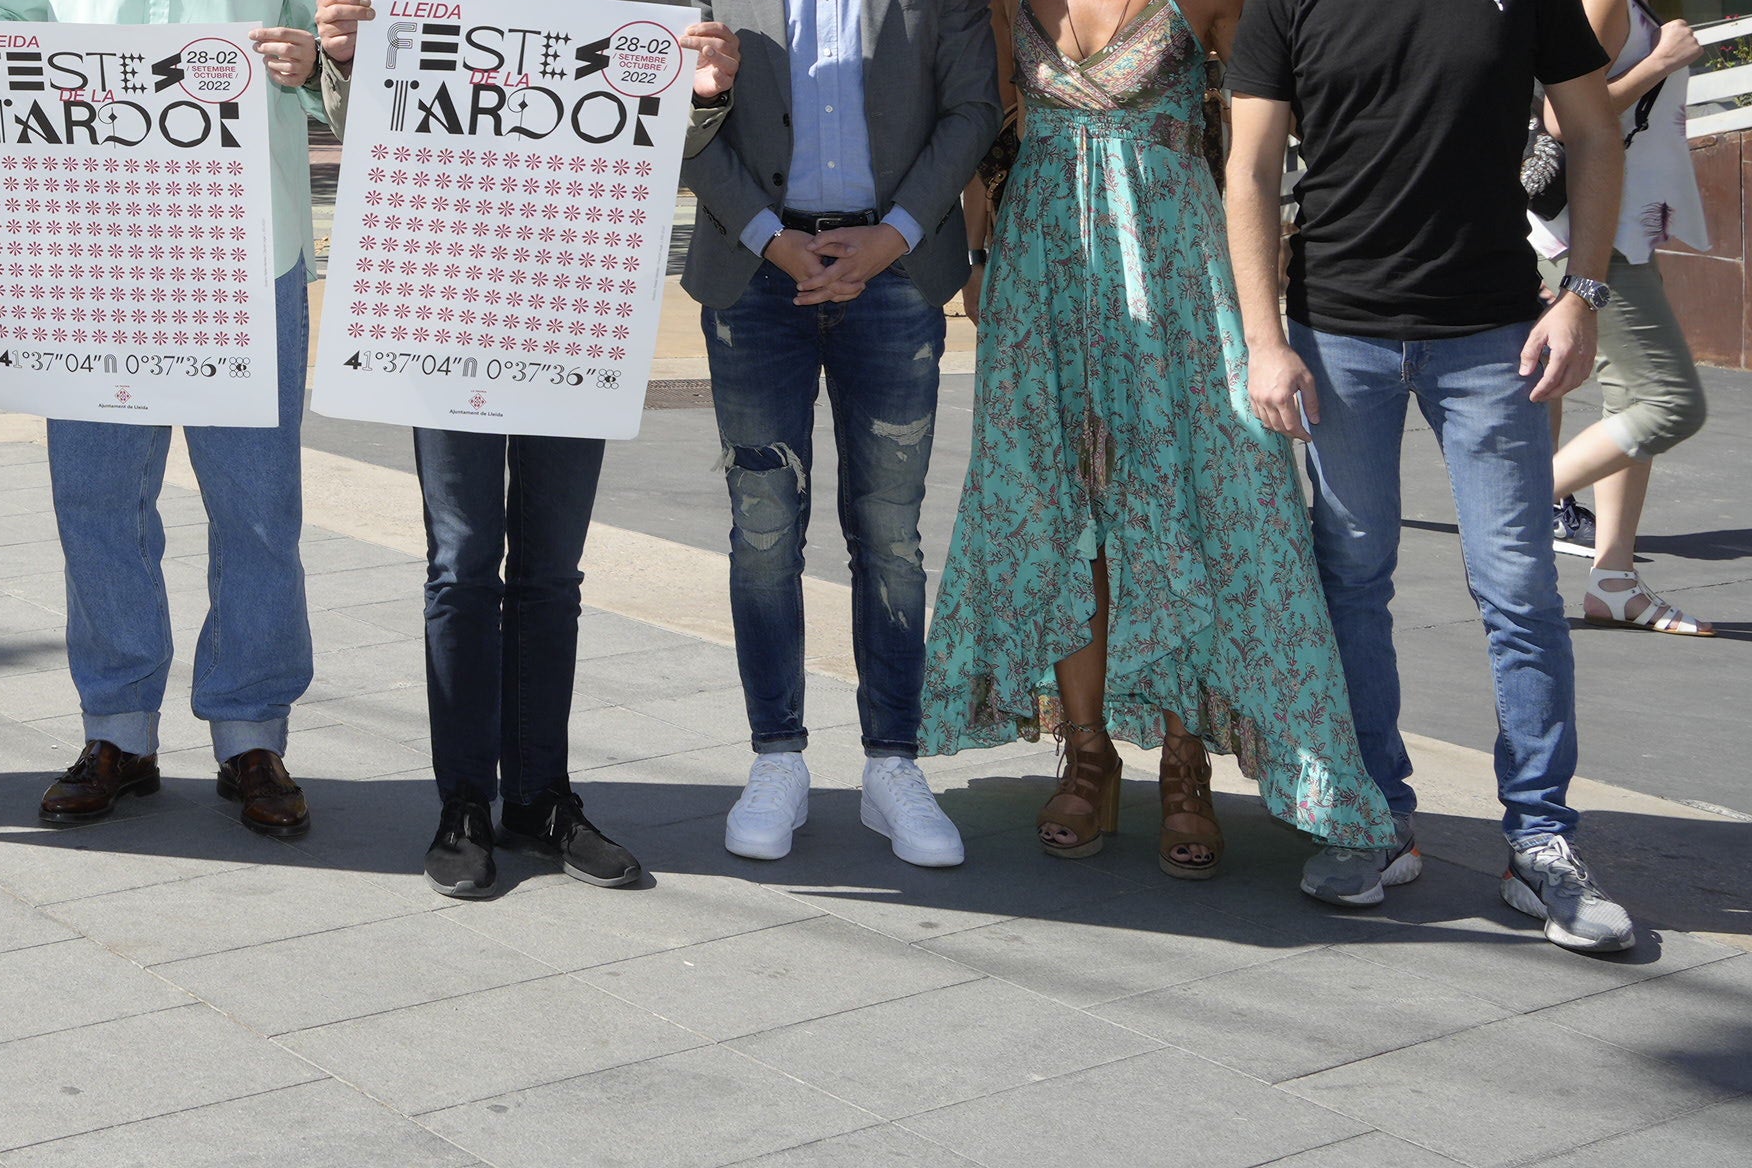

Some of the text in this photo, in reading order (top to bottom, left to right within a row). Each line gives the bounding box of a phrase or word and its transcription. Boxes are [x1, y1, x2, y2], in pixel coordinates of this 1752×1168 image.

[389, 0, 462, 20] LLEIDA
[385, 21, 611, 81] FESTES
[615, 36, 671, 55] 28-02
[186, 51, 238, 64] 28-02
[618, 53, 666, 64] SETEMBRE
[619, 61, 662, 71] OCTUBRE
[469, 69, 531, 87] DE LA
[621, 70, 657, 84] 2022
[198, 80, 231, 91] 2022
[59, 88, 115, 103] DE LA
